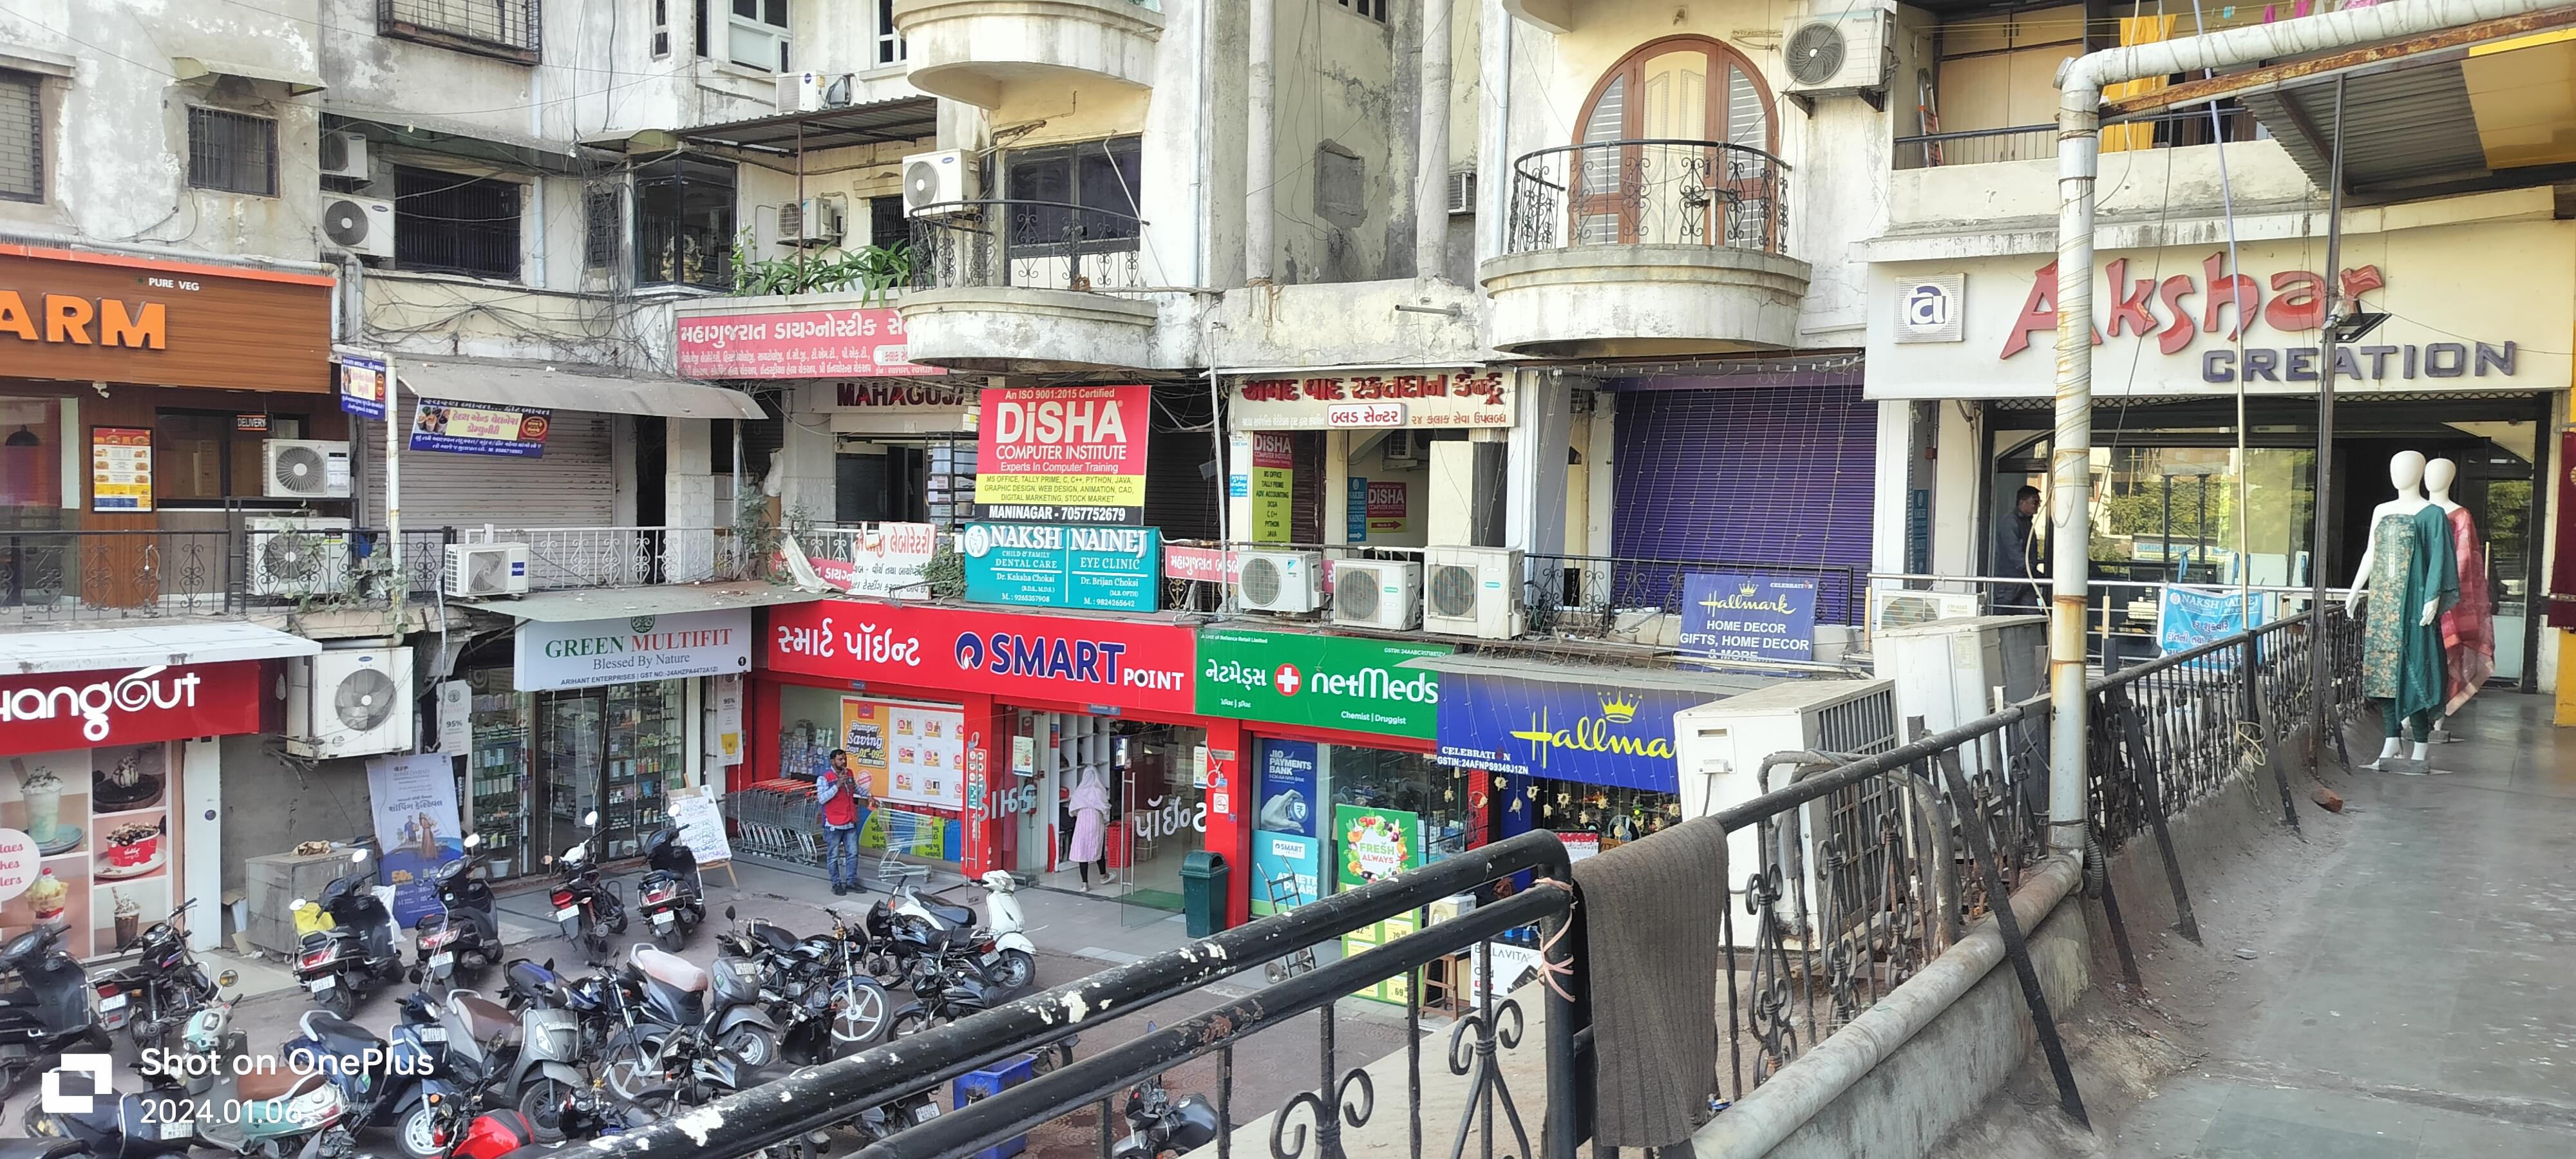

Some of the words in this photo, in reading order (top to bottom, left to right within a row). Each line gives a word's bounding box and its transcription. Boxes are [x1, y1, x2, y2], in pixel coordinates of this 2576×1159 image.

[148, 278, 174, 288] PURE
[178, 280, 200, 291] VEG
[2000, 251, 2383, 360] Akshar
[681, 323, 766, 349] મહાગુજરાત
[774, 312, 876, 339] ડાયગ્નોસ્ટીક
[2202, 341, 2515, 383] CREATION
[1005, 390, 1016, 400] An
[1019, 390, 1033, 399] ISO
[1036, 389, 1077, 399] 9001:2015
[1079, 388, 1115, 398] Certified
[1331, 410, 1359, 423] બ્લડ
[1364, 406, 1398, 423] સેન્ટર
[1412, 415, 1422, 425] ૨૪
[1426, 415, 1450, 424] કલાક
[1453, 411, 1470, 424] સેવા
[1473, 411, 1506, 424] ઉપલબ્ધ
[238, 417, 267, 428] DELIVERY
[996, 445, 1063, 460] COMPUTER
[1065, 445, 1127, 460] INSTITUTE
[1001, 462, 1030, 472] Experts
[1032, 462, 1040, 471] In
[1042, 462, 1083, 473] Computer
[1085, 462, 1119, 474] Training
[1081, 485, 1117, 494] ANIMATION,
[1025, 494, 1063, 502] MARKETING,
[989, 505, 1052, 520] MANINAGAR
[1061, 507, 1126, 522] 7057752679
[990, 525, 1063, 550] NAKSH
[1070, 527, 1148, 558] NAINEJ
[995, 558, 1031, 567] DENTAL
[1032, 560, 1058, 569] CARE
[1080, 557, 1100, 569] EYE
[1102, 558, 1140, 570] CLINIC
[1171, 555, 1212, 576] મહાગુજરાત
[1007, 573, 1031, 581] Kaksha
[1032, 574, 1055, 582] Choksi
[1081, 576, 1092, 585] Dr.
[1092, 578, 1113, 587] Brijan
[1114, 578, 1139, 587] Choksi
[1096, 598, 1135, 607] 9824265642
[1698, 590, 1797, 617] Hallmark
[2183, 594, 2219, 608] NAKSH
[1707, 620, 1741, 631] HOME
[1743, 622, 1786, 634] DECOR
[545, 635, 625, 659] GREEN
[631, 628, 733, 652] MULTIFIT
[777, 617, 835, 657] સ્માર્ટ
[1680, 633, 1718, 647] GIFTS,
[1722, 635, 1759, 648] HOME
[1763, 637, 1809, 651] DECOR
[592, 657, 634, 670] Blessed
[638, 655, 652, 669] By
[656, 652, 690, 665] Nature
[990, 632, 1126, 684] SMART
[1123, 668, 1184, 691] POINT
[561, 677, 591, 685] ARIHANT
[591, 673, 636, 683] ENTERPRISES
[1205, 659, 1267, 691] નેટમેડ્સ
[1311, 668, 1438, 704] netMeds
[446, 720, 463, 728] 95%
[1340, 711, 1370, 721] Chemist
[1374, 713, 1406, 725] Druggist
[852, 722, 879, 733] Bumper
[847, 732, 883, 749] Saving
[1269, 749, 1284, 759] JIO
[1269, 757, 1312, 770] PAYMENTS
[1269, 765, 1293, 776] BANK
[1280, 844, 1302, 853] SMART
[1361, 853, 1394, 864] ALWAYS
[1395, 987, 1403, 996] 69
